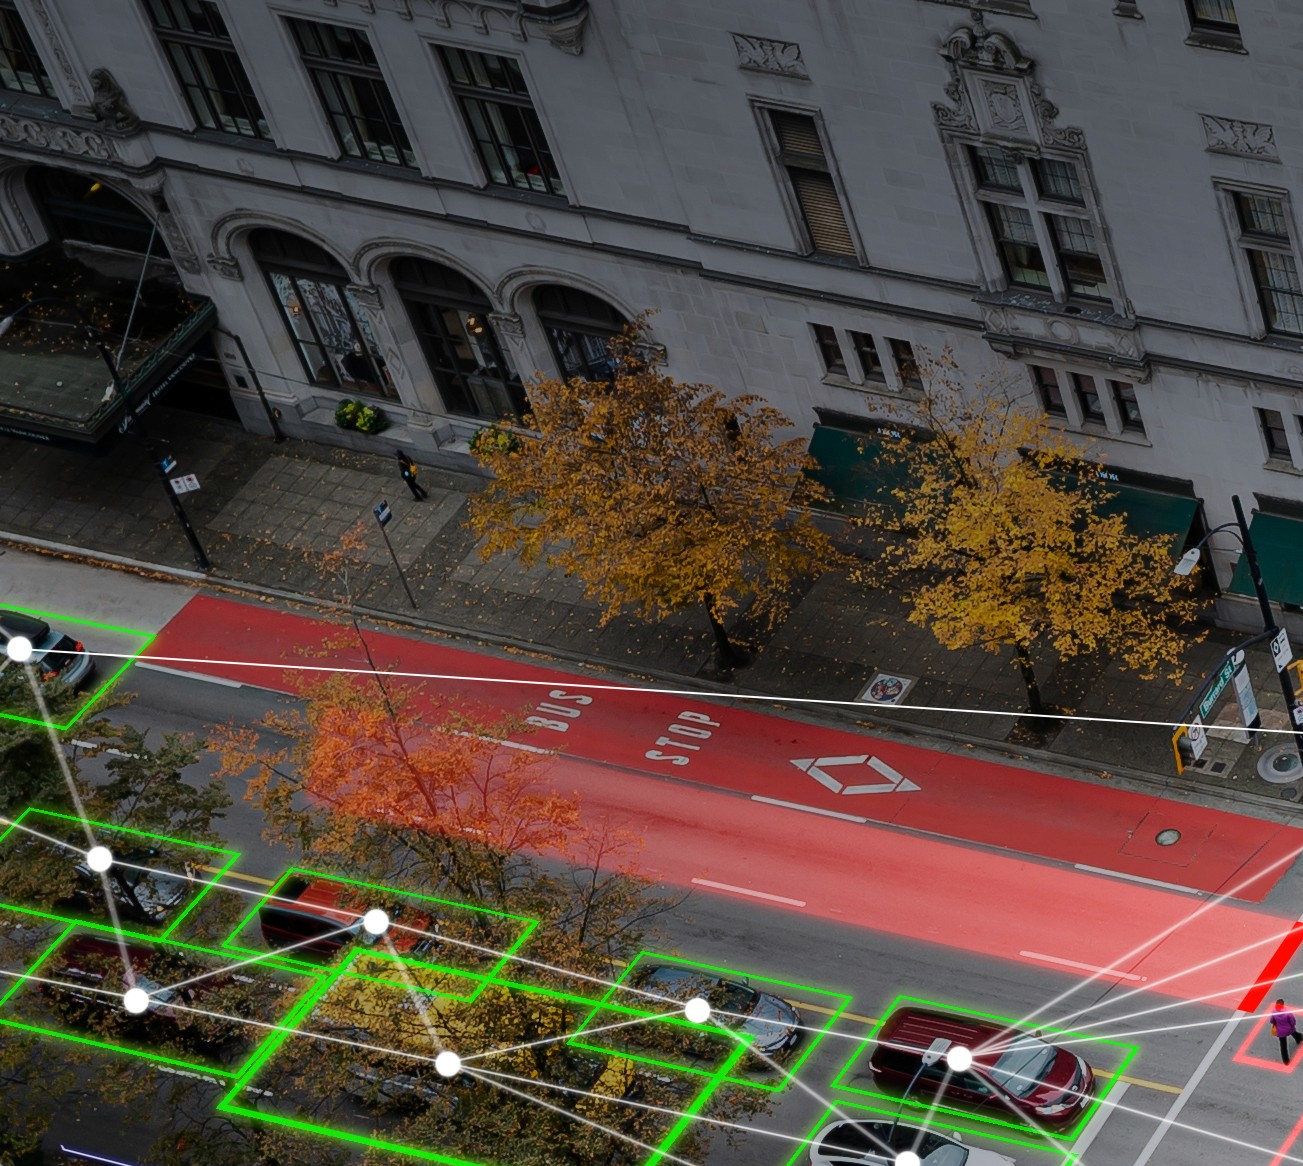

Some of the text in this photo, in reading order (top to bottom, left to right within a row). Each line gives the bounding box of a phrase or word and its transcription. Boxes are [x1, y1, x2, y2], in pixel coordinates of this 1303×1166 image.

[525, 688, 594, 733] BUS
[1202, 678, 1225, 712] Burrard
[645, 710, 721, 766] STOP
